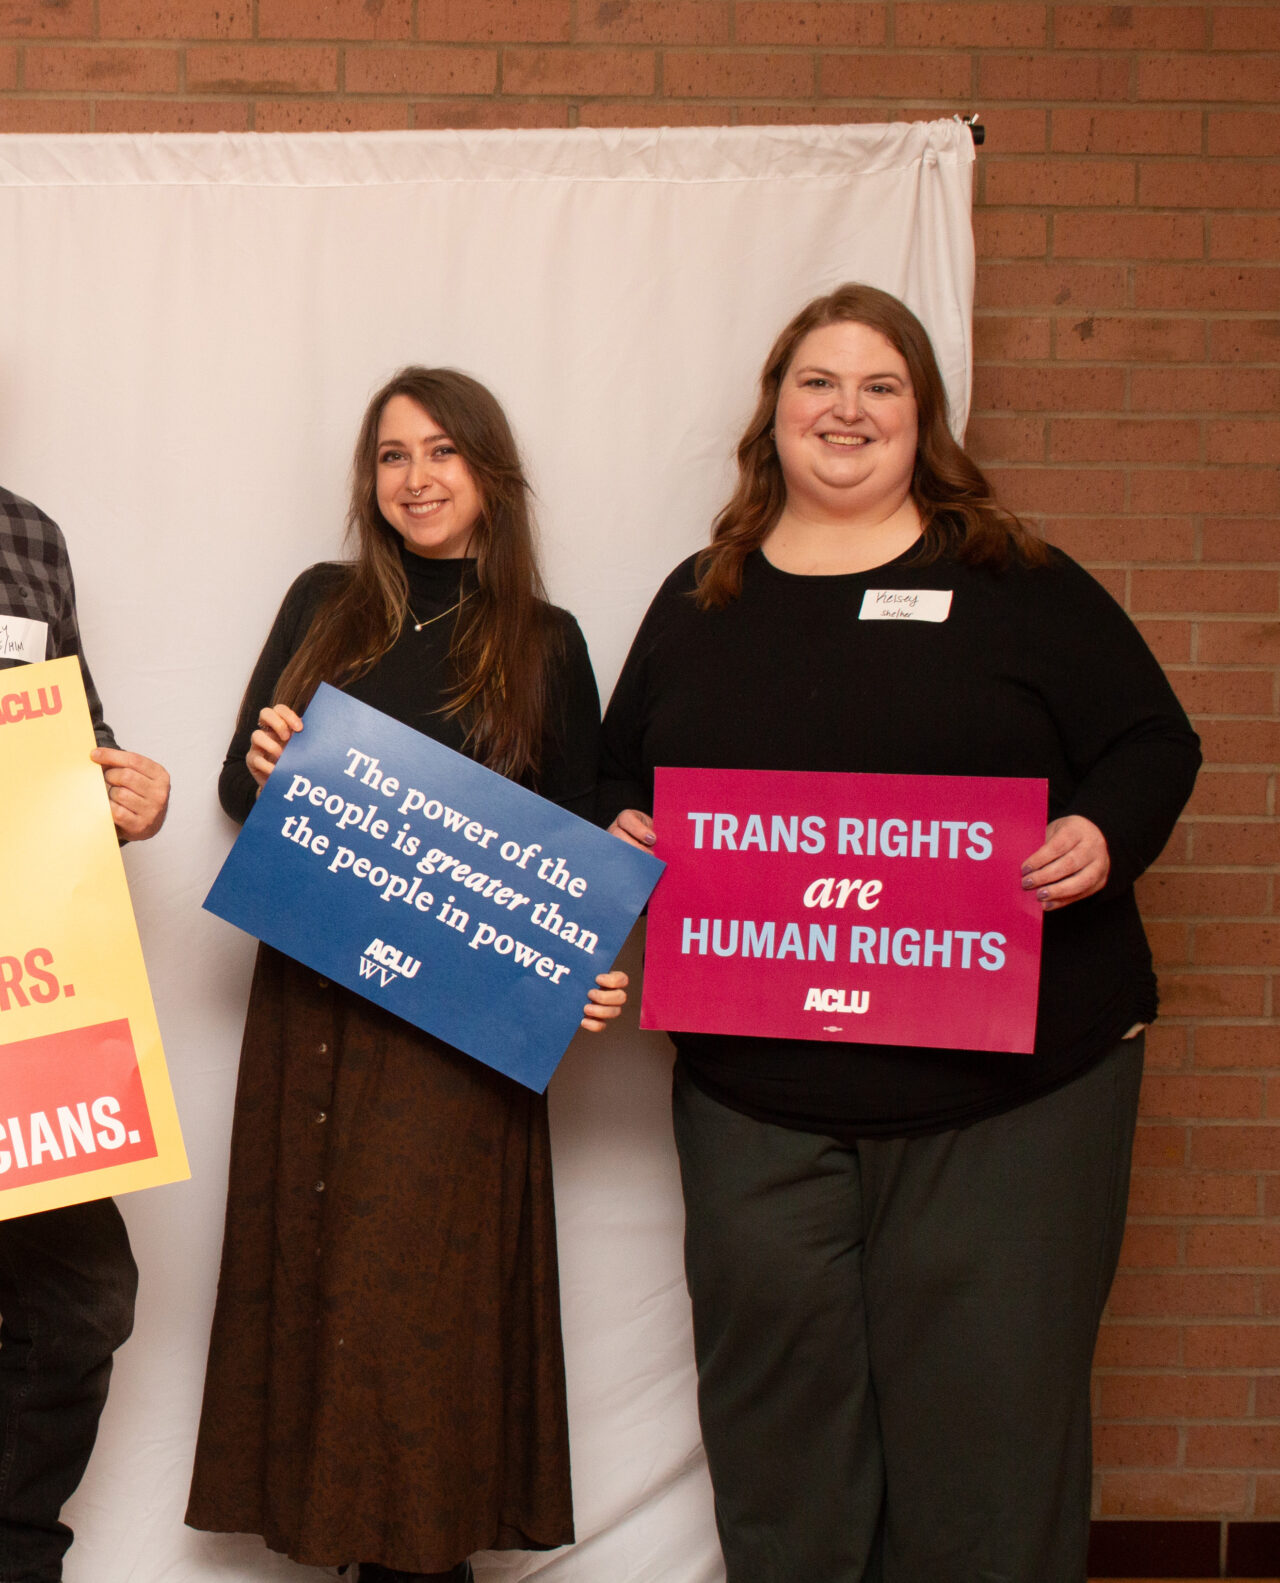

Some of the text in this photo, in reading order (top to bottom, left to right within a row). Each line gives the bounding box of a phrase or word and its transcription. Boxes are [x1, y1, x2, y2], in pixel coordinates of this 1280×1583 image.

[344, 748, 588, 898] The power of the
[687, 812, 994, 861] TRANS RIGHTS
[284, 774, 600, 954] people is greater than
[280, 813, 570, 985] the people in power
[803, 877, 883, 911] are
[364, 938, 422, 978] ACLU
[681, 917, 1007, 971] HUMAN RIGHTS
[358, 955, 398, 988] WV
[803, 988, 870, 1014] ACLU
